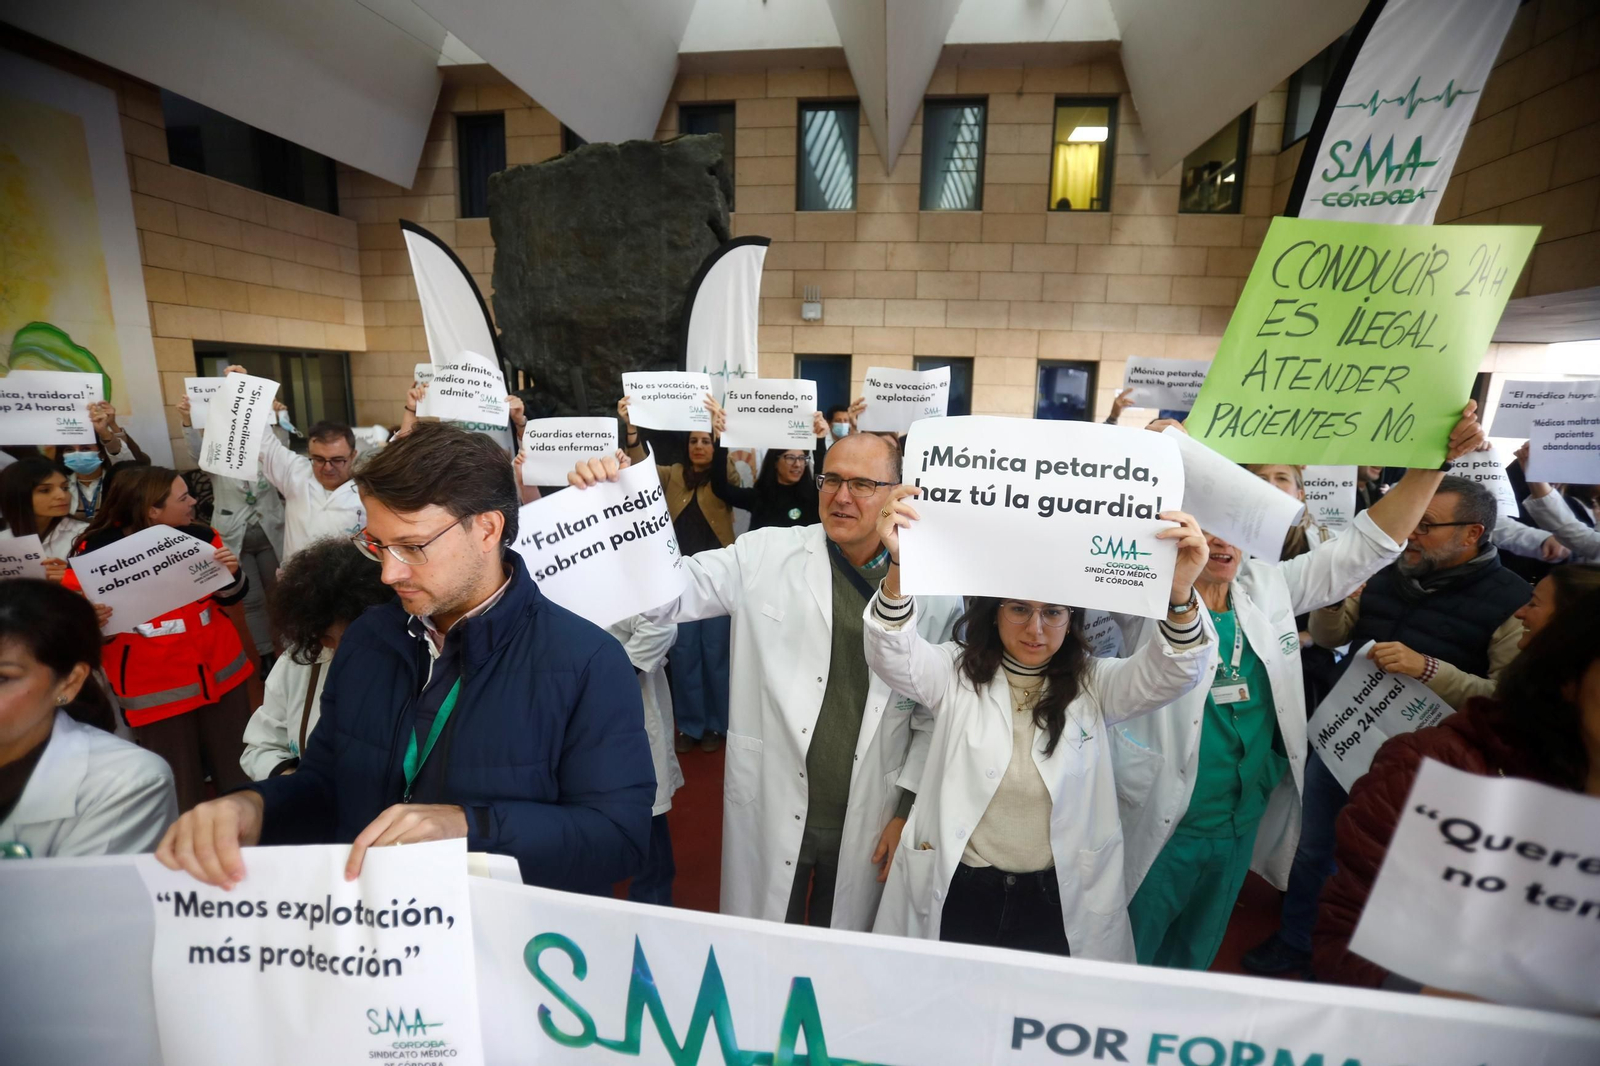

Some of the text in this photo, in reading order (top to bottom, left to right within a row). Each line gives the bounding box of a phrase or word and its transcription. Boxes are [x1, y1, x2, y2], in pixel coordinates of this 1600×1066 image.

[1322, 133, 1441, 188] SMA
[1321, 185, 1427, 207] CÓRDOBA
[1256, 298, 1319, 338] ES
[434, 374, 465, 384] médico
[467, 378, 480, 386] no
[483, 380, 492, 388] te
[461, 363, 495, 379] dimite,
[1146, 377, 1155, 385] tú
[1156, 378, 1165, 386] la
[1241, 349, 1410, 394] ATENDER
[27, 391, 85, 400] traidora!
[237, 381, 246, 394] no
[657, 381, 698, 390] vocación,
[755, 391, 798, 401] fonendo,
[896, 382, 938, 391] vocación,
[15, 403, 32, 411] 24
[36, 403, 76, 412] horas!
[231, 395, 245, 416] hay
[575, 430, 615, 440] eternas,
[1371, 402, 1414, 443] NO.
[1554, 430, 1594, 440] pacientes
[236, 407, 253, 469] conciliación,
[530, 442, 555, 451] vidas
[921, 445, 1159, 487] ¡Mónica petarda,
[913, 478, 1163, 520] haz tú la guardia!
[521, 513, 599, 550] “Faltan
[90, 533, 193, 577] “Faltan médicos,
[1090, 535, 1152, 560] SMA
[534, 540, 606, 582] sobran
[1084, 566, 1157, 580] SINDICATO MÉDICO
[97, 568, 150, 594] sobran
[1106, 576, 1144, 587] CÓRDOBA
[1318, 705, 1359, 749] ¡Mónica,
[1334, 678, 1406, 761] ¡Stop 24 horas!
[1441, 866, 1507, 893] no
[156, 891, 456, 931] “Menos explotación,
[188, 936, 420, 978] más protección”
[523, 932, 832, 1066] SMA
[366, 1006, 443, 1038] SMA
[1011, 1016, 1128, 1062] POR
[368, 1048, 457, 1059] SINDICATO MÉDICO
